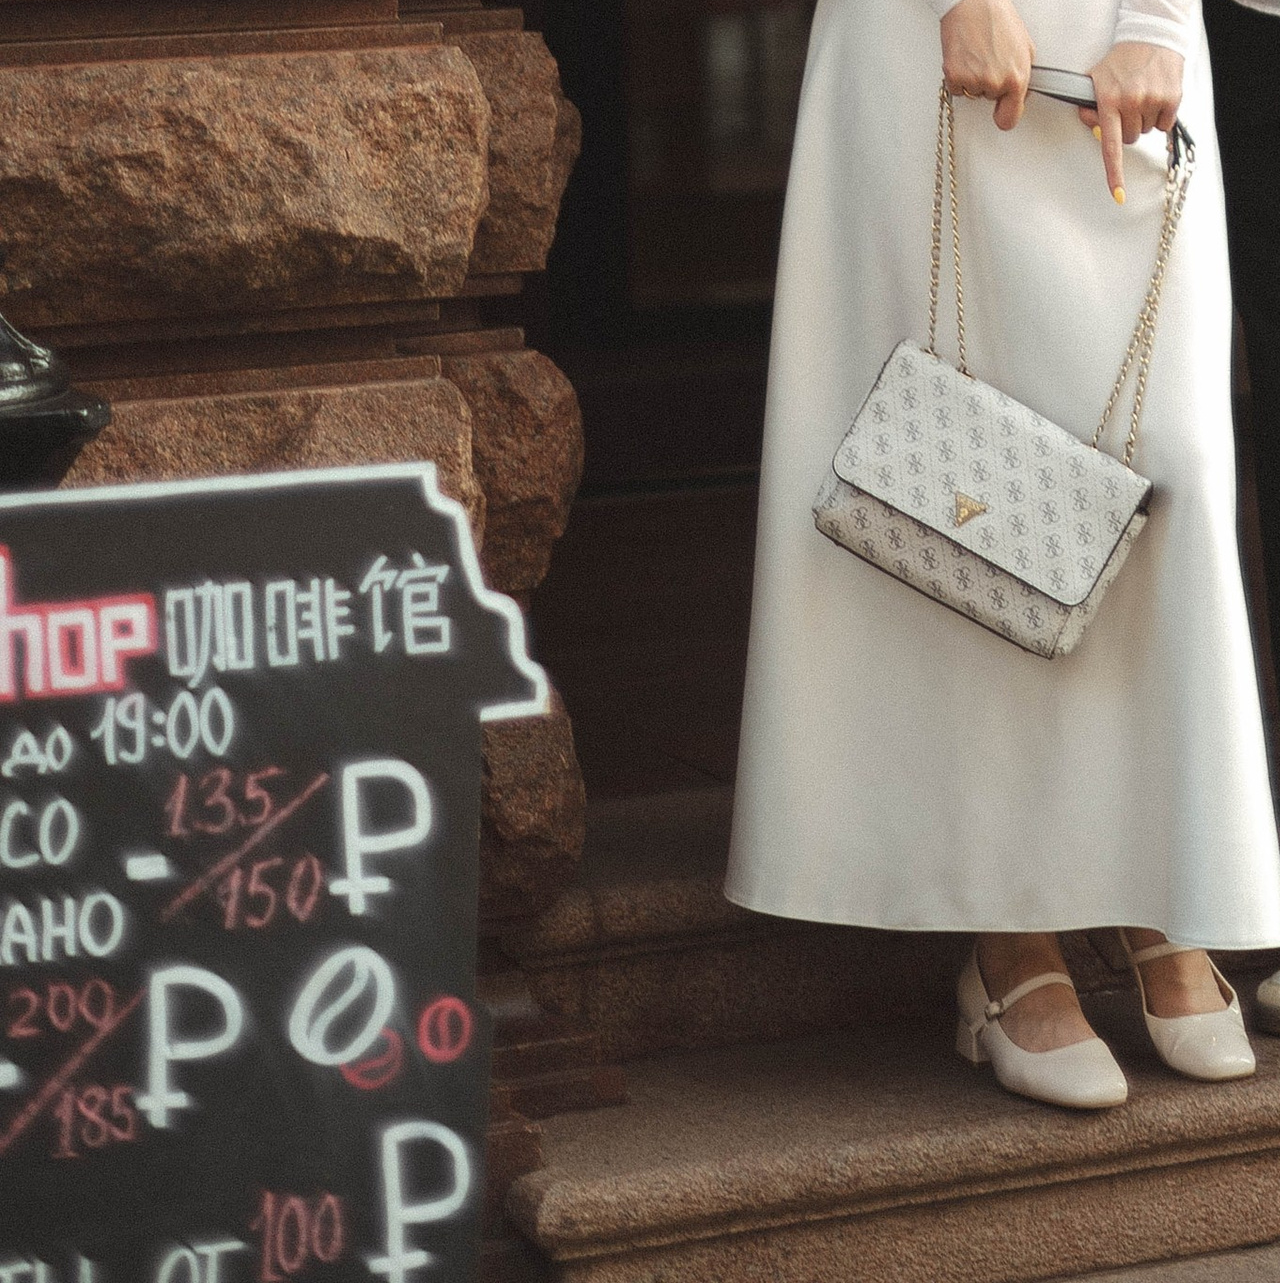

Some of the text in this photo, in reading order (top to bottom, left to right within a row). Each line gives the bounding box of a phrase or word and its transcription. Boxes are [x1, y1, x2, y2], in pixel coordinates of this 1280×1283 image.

[164, 553, 451, 689] 咖啡馆
[91, 687, 234, 765] 19:00
[0, 891, 125, 965] АНО
[251, 1188, 344, 1282] 100
